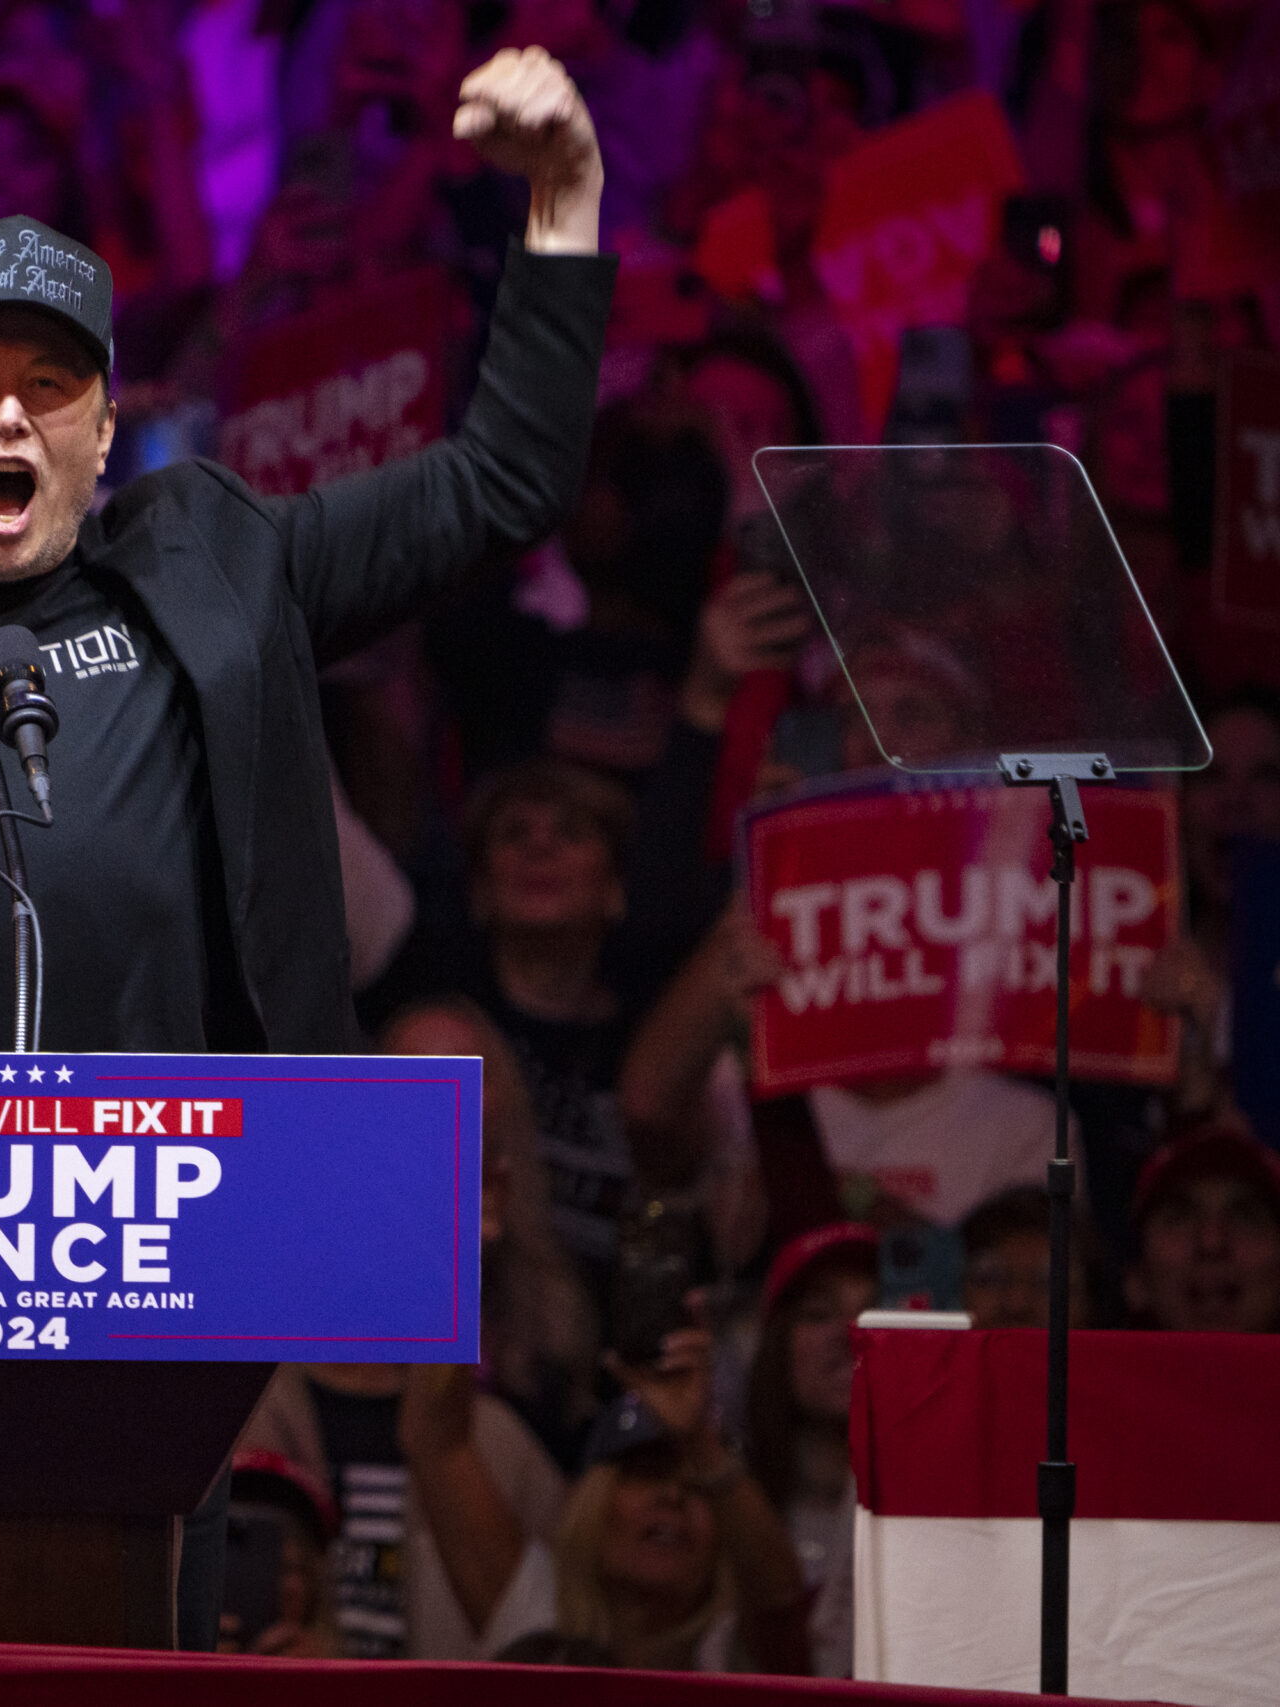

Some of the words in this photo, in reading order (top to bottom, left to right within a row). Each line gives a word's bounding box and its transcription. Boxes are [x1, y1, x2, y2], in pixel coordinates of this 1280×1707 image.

[12, 229, 97, 286] America
[20, 265, 83, 313] Again
[770, 865, 1157, 961] TRUMP
[778, 947, 947, 1016] WILL
[1089, 943, 1155, 999] IT
[93, 1101, 168, 1135] FIX
[181, 1101, 223, 1135] IT
[16, 1291, 98, 1309] GREAT
[106, 1292, 195, 1310] AGAIN!
